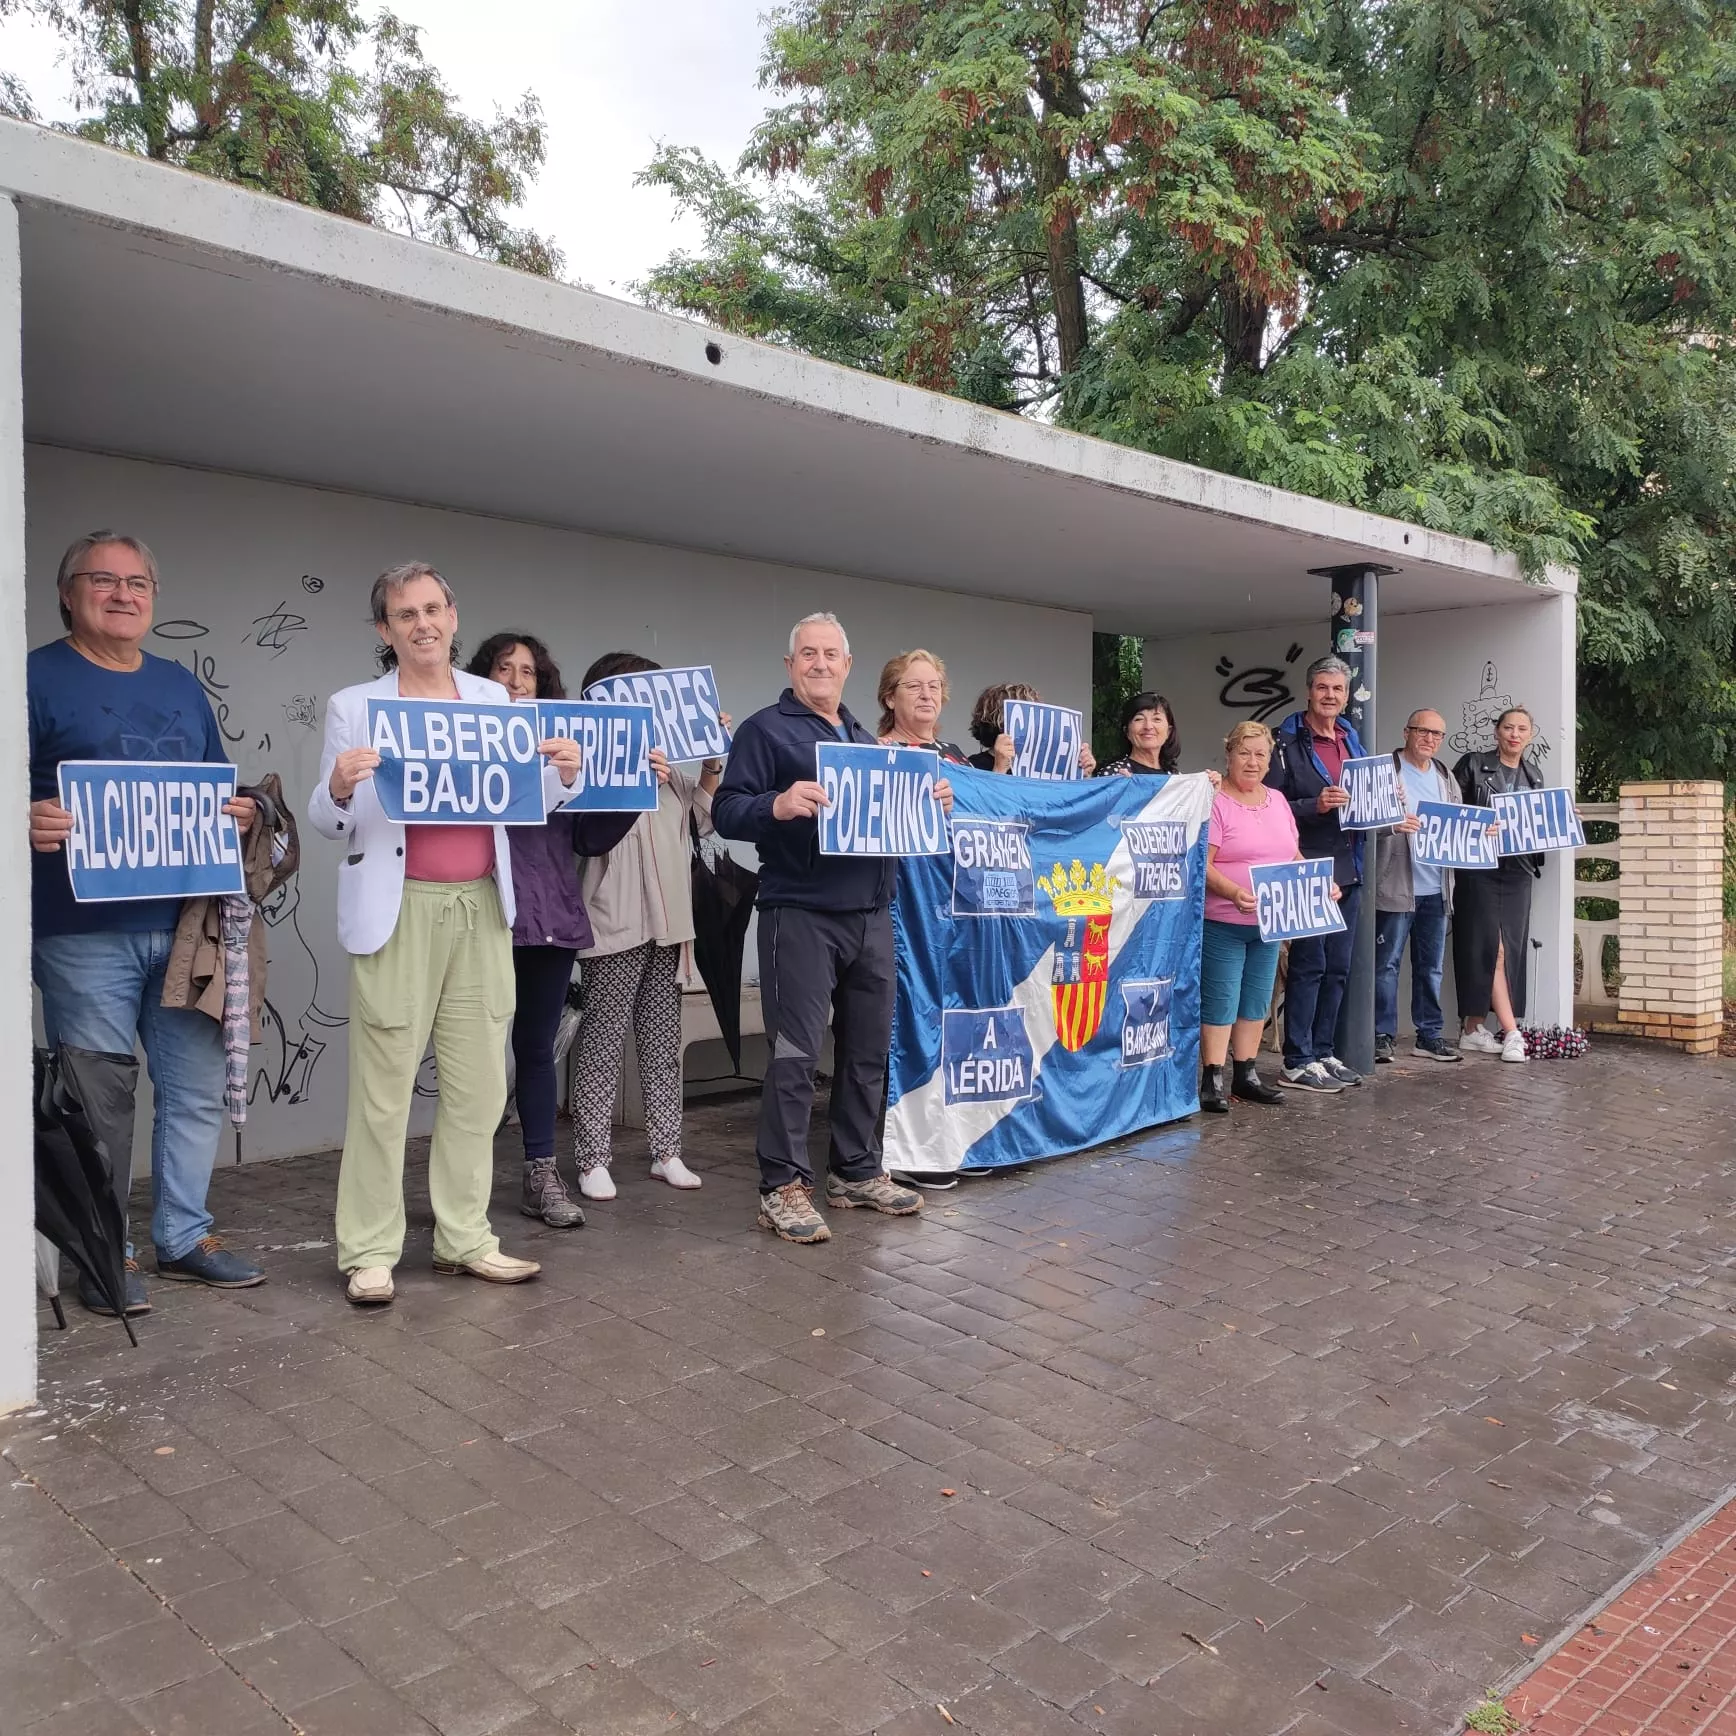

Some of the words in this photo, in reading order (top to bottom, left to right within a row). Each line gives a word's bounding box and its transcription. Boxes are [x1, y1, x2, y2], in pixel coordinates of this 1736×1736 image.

[373, 710, 535, 763] ALBERO
[1009, 704, 1081, 780] CALLEN
[403, 762, 510, 814] BAJO
[822, 750, 939, 852] POLEÑINO
[70, 780, 238, 869] ALCUBIERRE
[1494, 789, 1581, 854] FRAELLA
[1137, 862, 1181, 891] TRENES
[983, 1016, 997, 1049] A
[949, 1053, 1024, 1095] LÉRIDA
